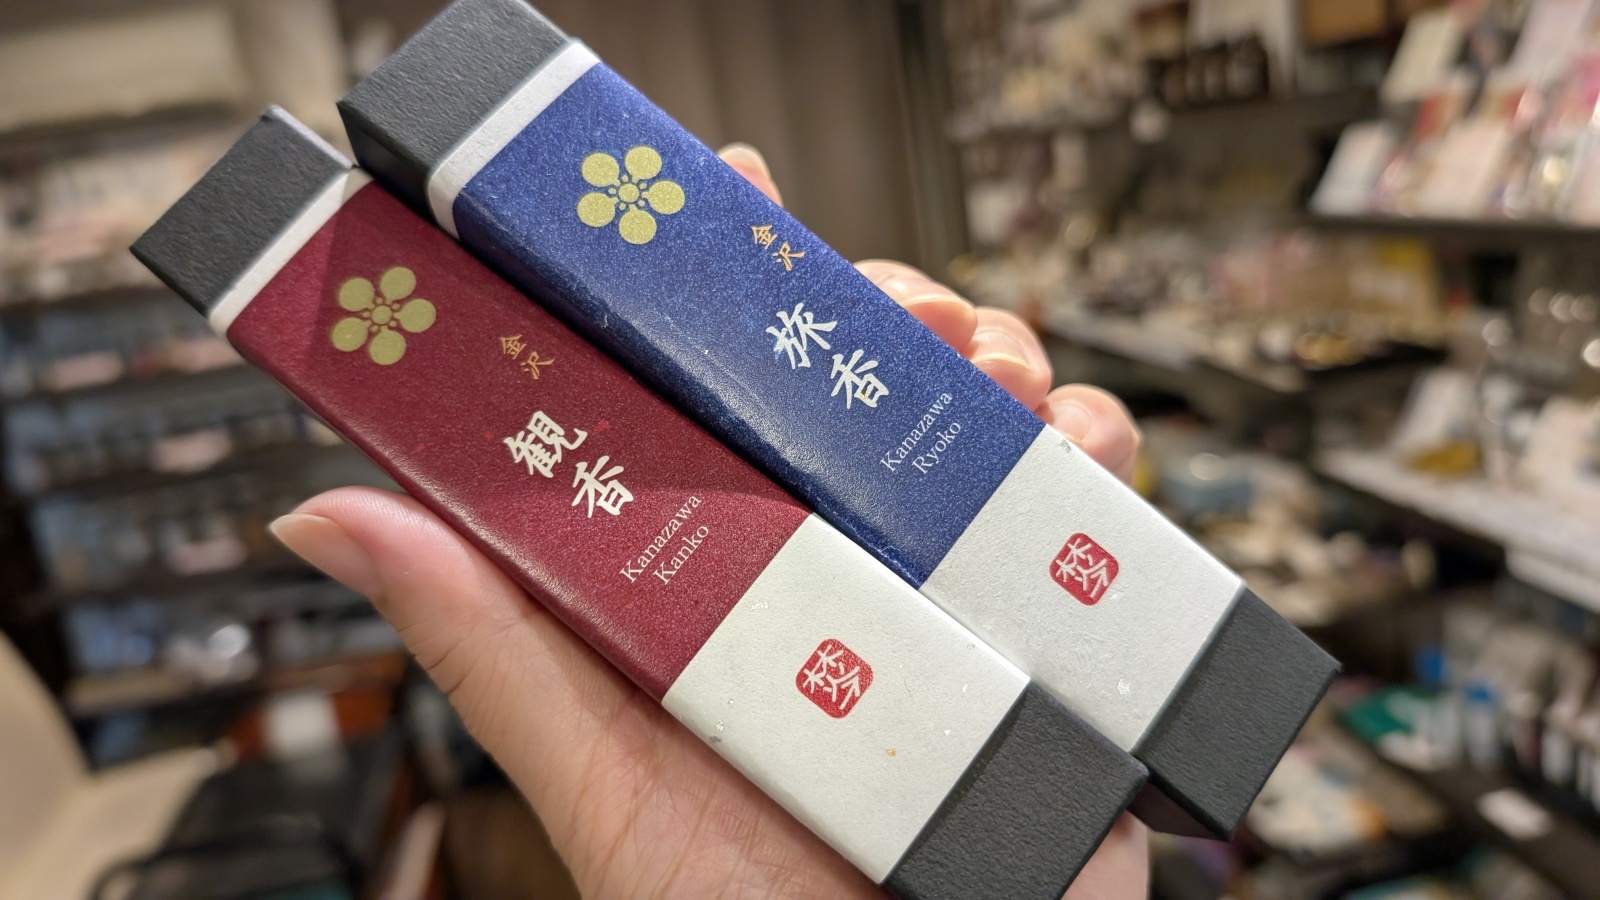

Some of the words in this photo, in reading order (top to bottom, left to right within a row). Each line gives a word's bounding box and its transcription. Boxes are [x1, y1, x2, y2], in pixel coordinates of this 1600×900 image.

[751, 224, 805, 271] 金沢
[499, 334, 555, 380] 金沢
[765, 302, 889, 409] 旅香
[503, 410, 634, 518] 観香
[880, 392, 952, 472] Kanazawa
[912, 422, 961, 474] Ryoko
[620, 496, 701, 583] Kanazawa
[653, 526, 709, 585] Kanko
